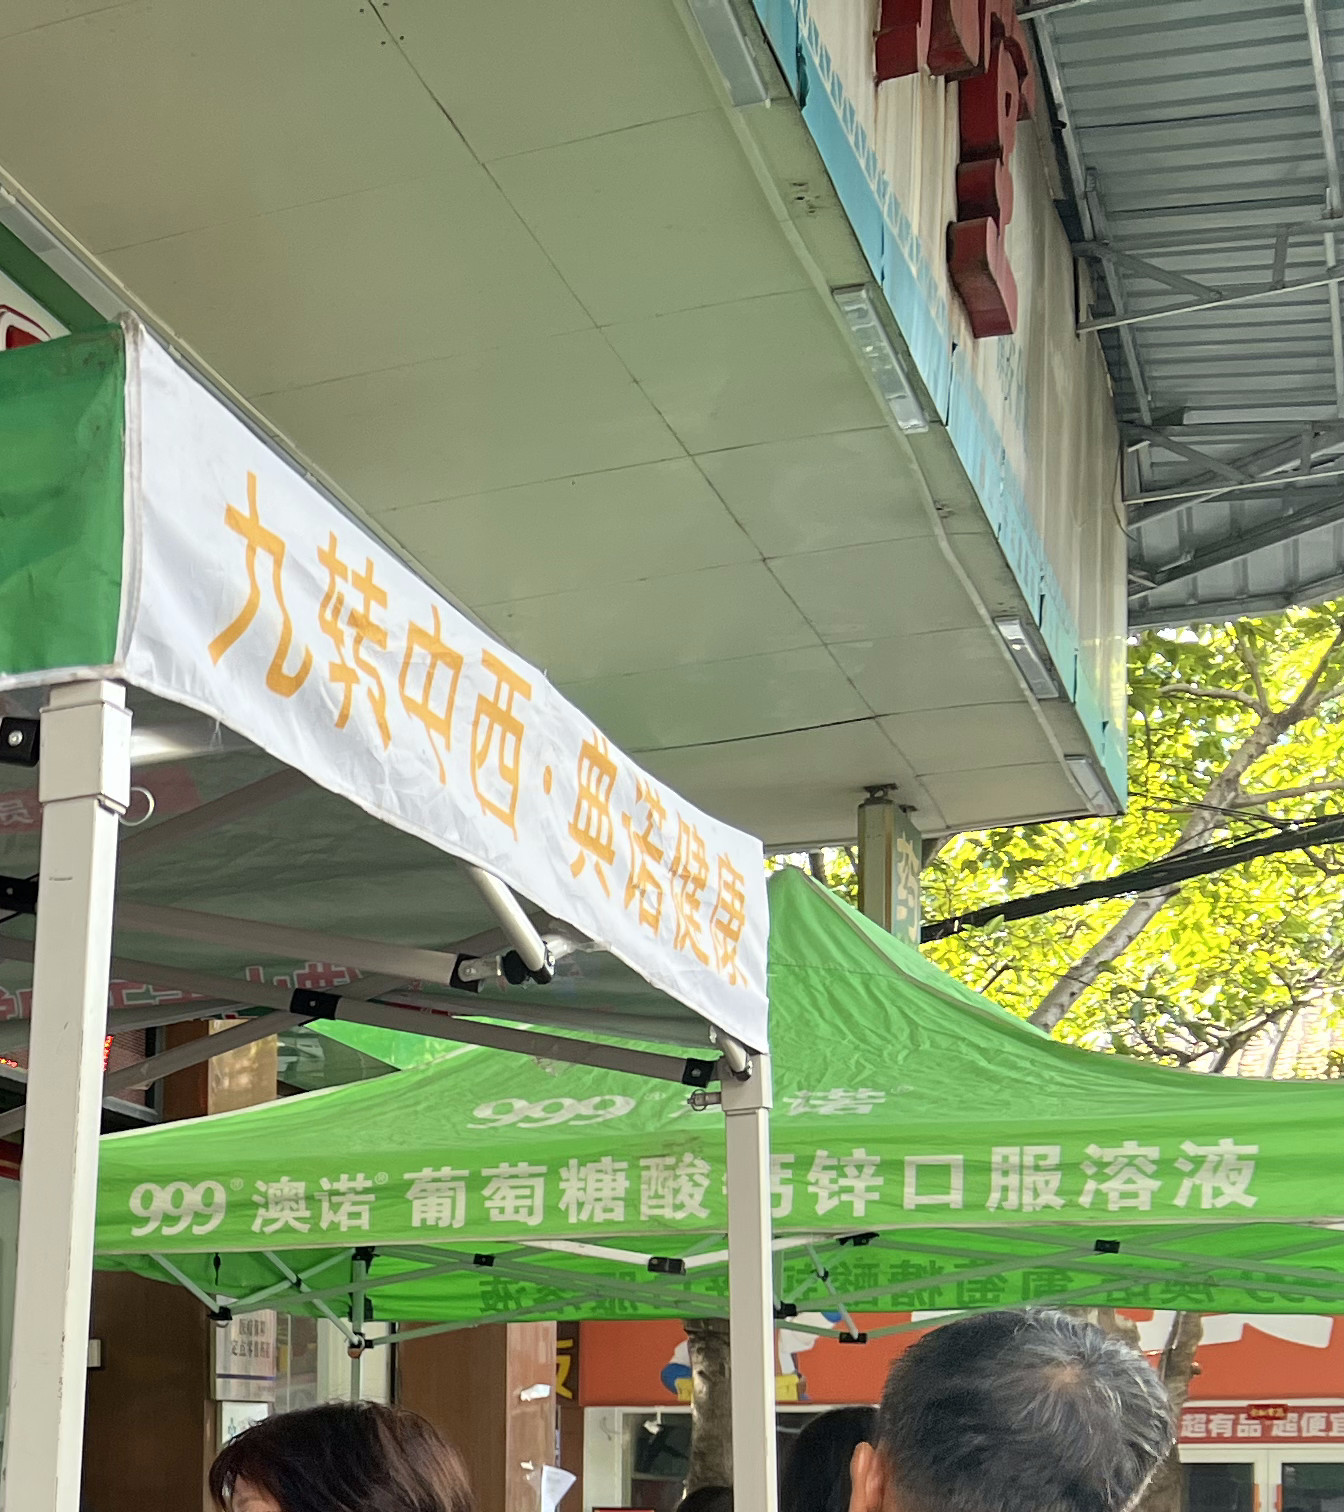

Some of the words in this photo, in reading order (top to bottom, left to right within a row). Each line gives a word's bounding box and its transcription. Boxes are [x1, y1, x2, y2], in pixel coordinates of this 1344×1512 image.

[128, 1179, 227, 1237] 999
[1180, 1413, 1263, 1438] 超有品
